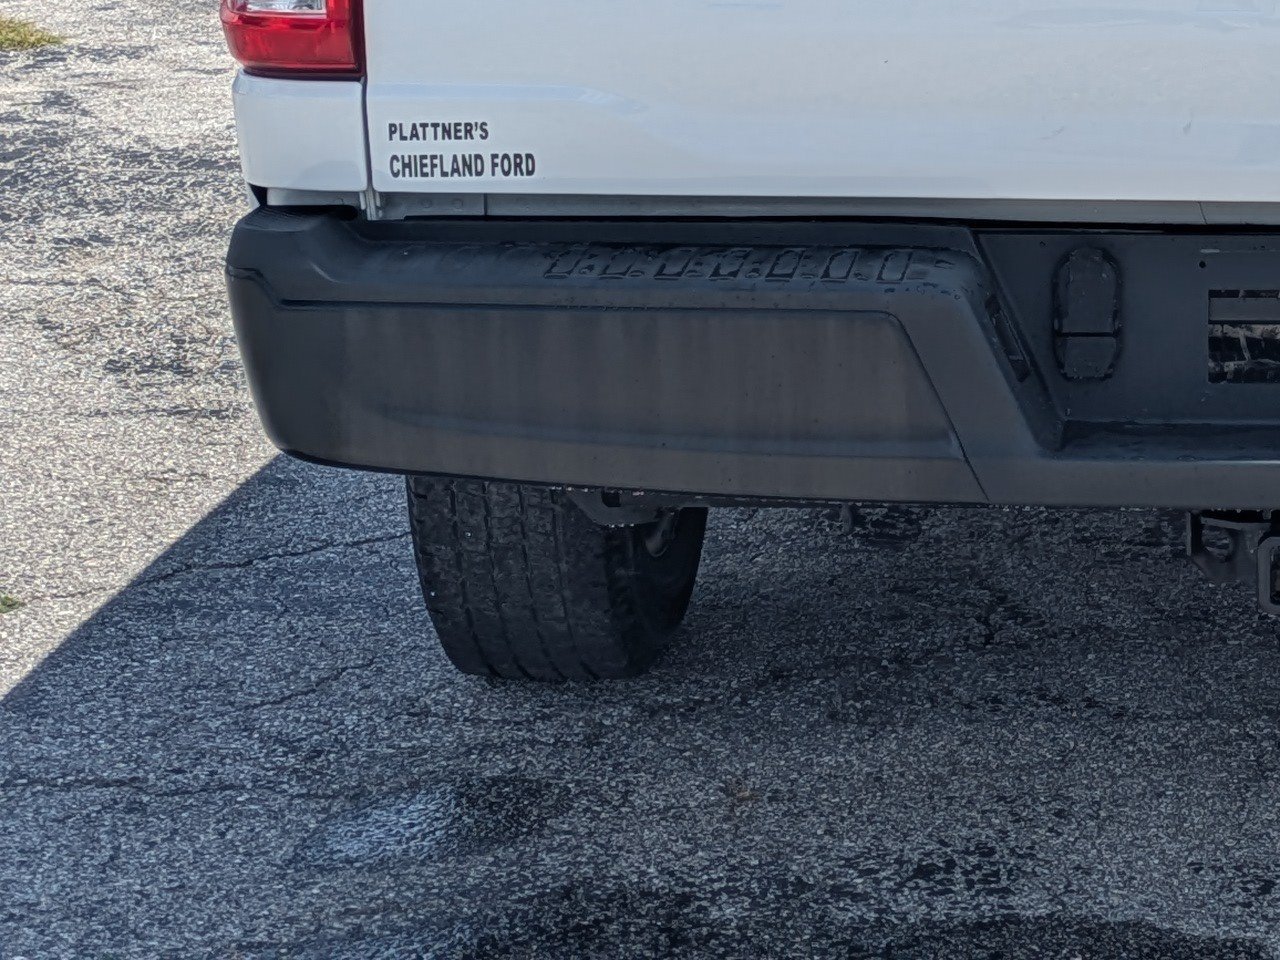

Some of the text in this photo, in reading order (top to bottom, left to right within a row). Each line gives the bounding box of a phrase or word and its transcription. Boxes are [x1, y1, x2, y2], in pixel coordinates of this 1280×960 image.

[388, 122, 489, 141] PLATTNER'S
[389, 153, 536, 178] CHIEFLAND FORD
